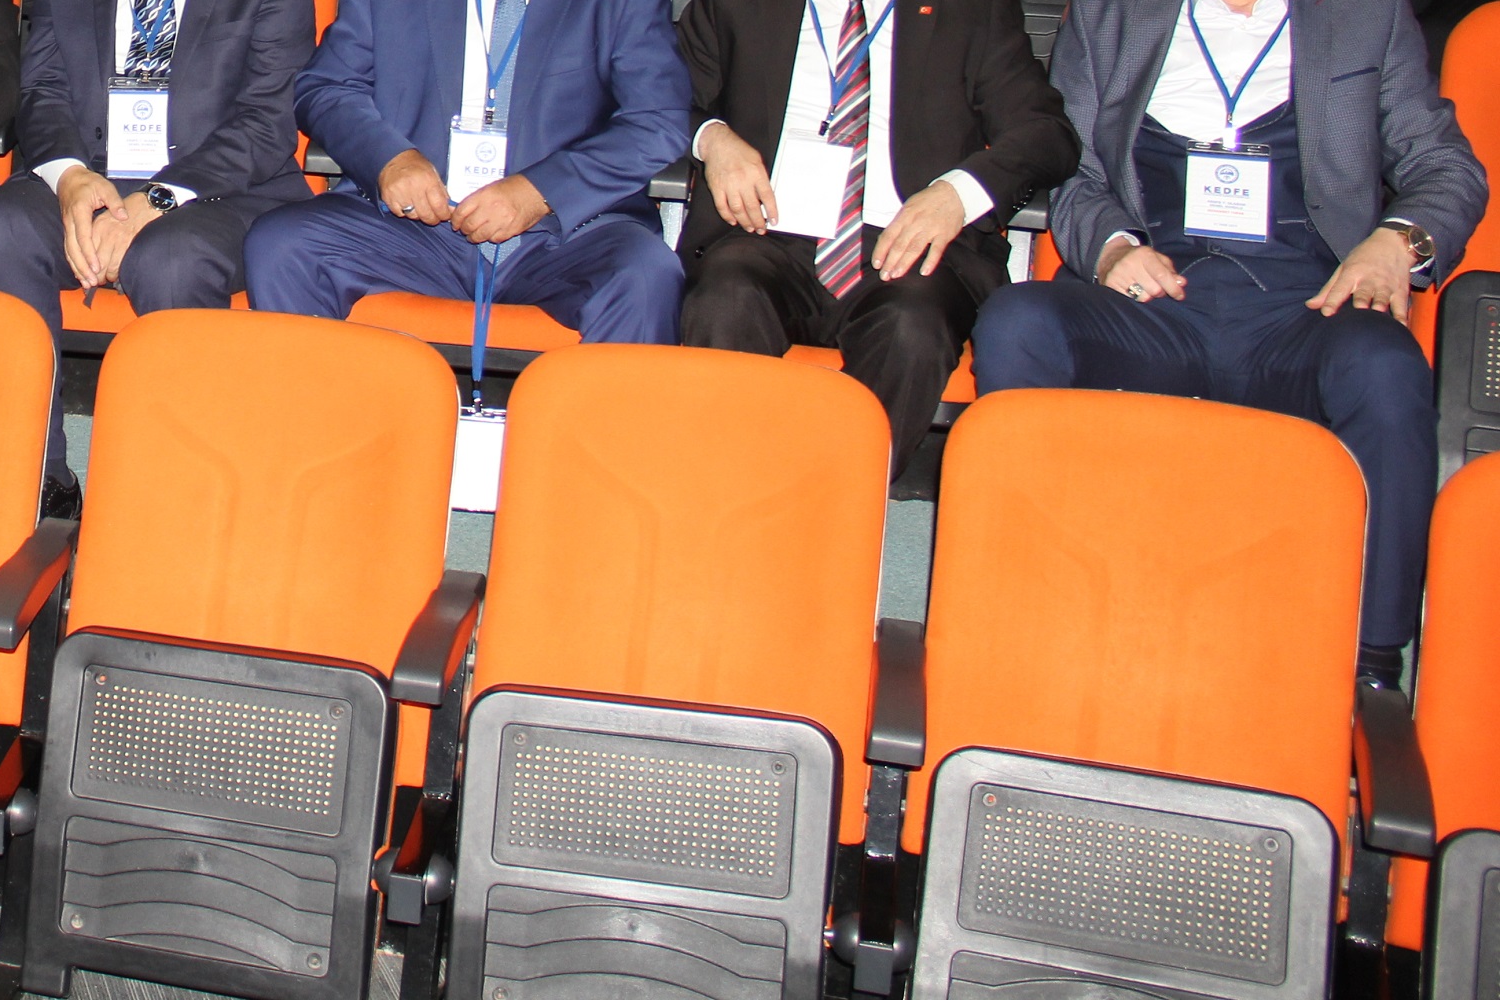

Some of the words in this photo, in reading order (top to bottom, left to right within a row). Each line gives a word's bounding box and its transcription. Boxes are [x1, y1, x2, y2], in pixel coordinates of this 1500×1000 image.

[123, 124, 162, 132] KEDFE
[464, 165, 505, 176] KEDFE
[1203, 185, 1250, 197] KEDFE
